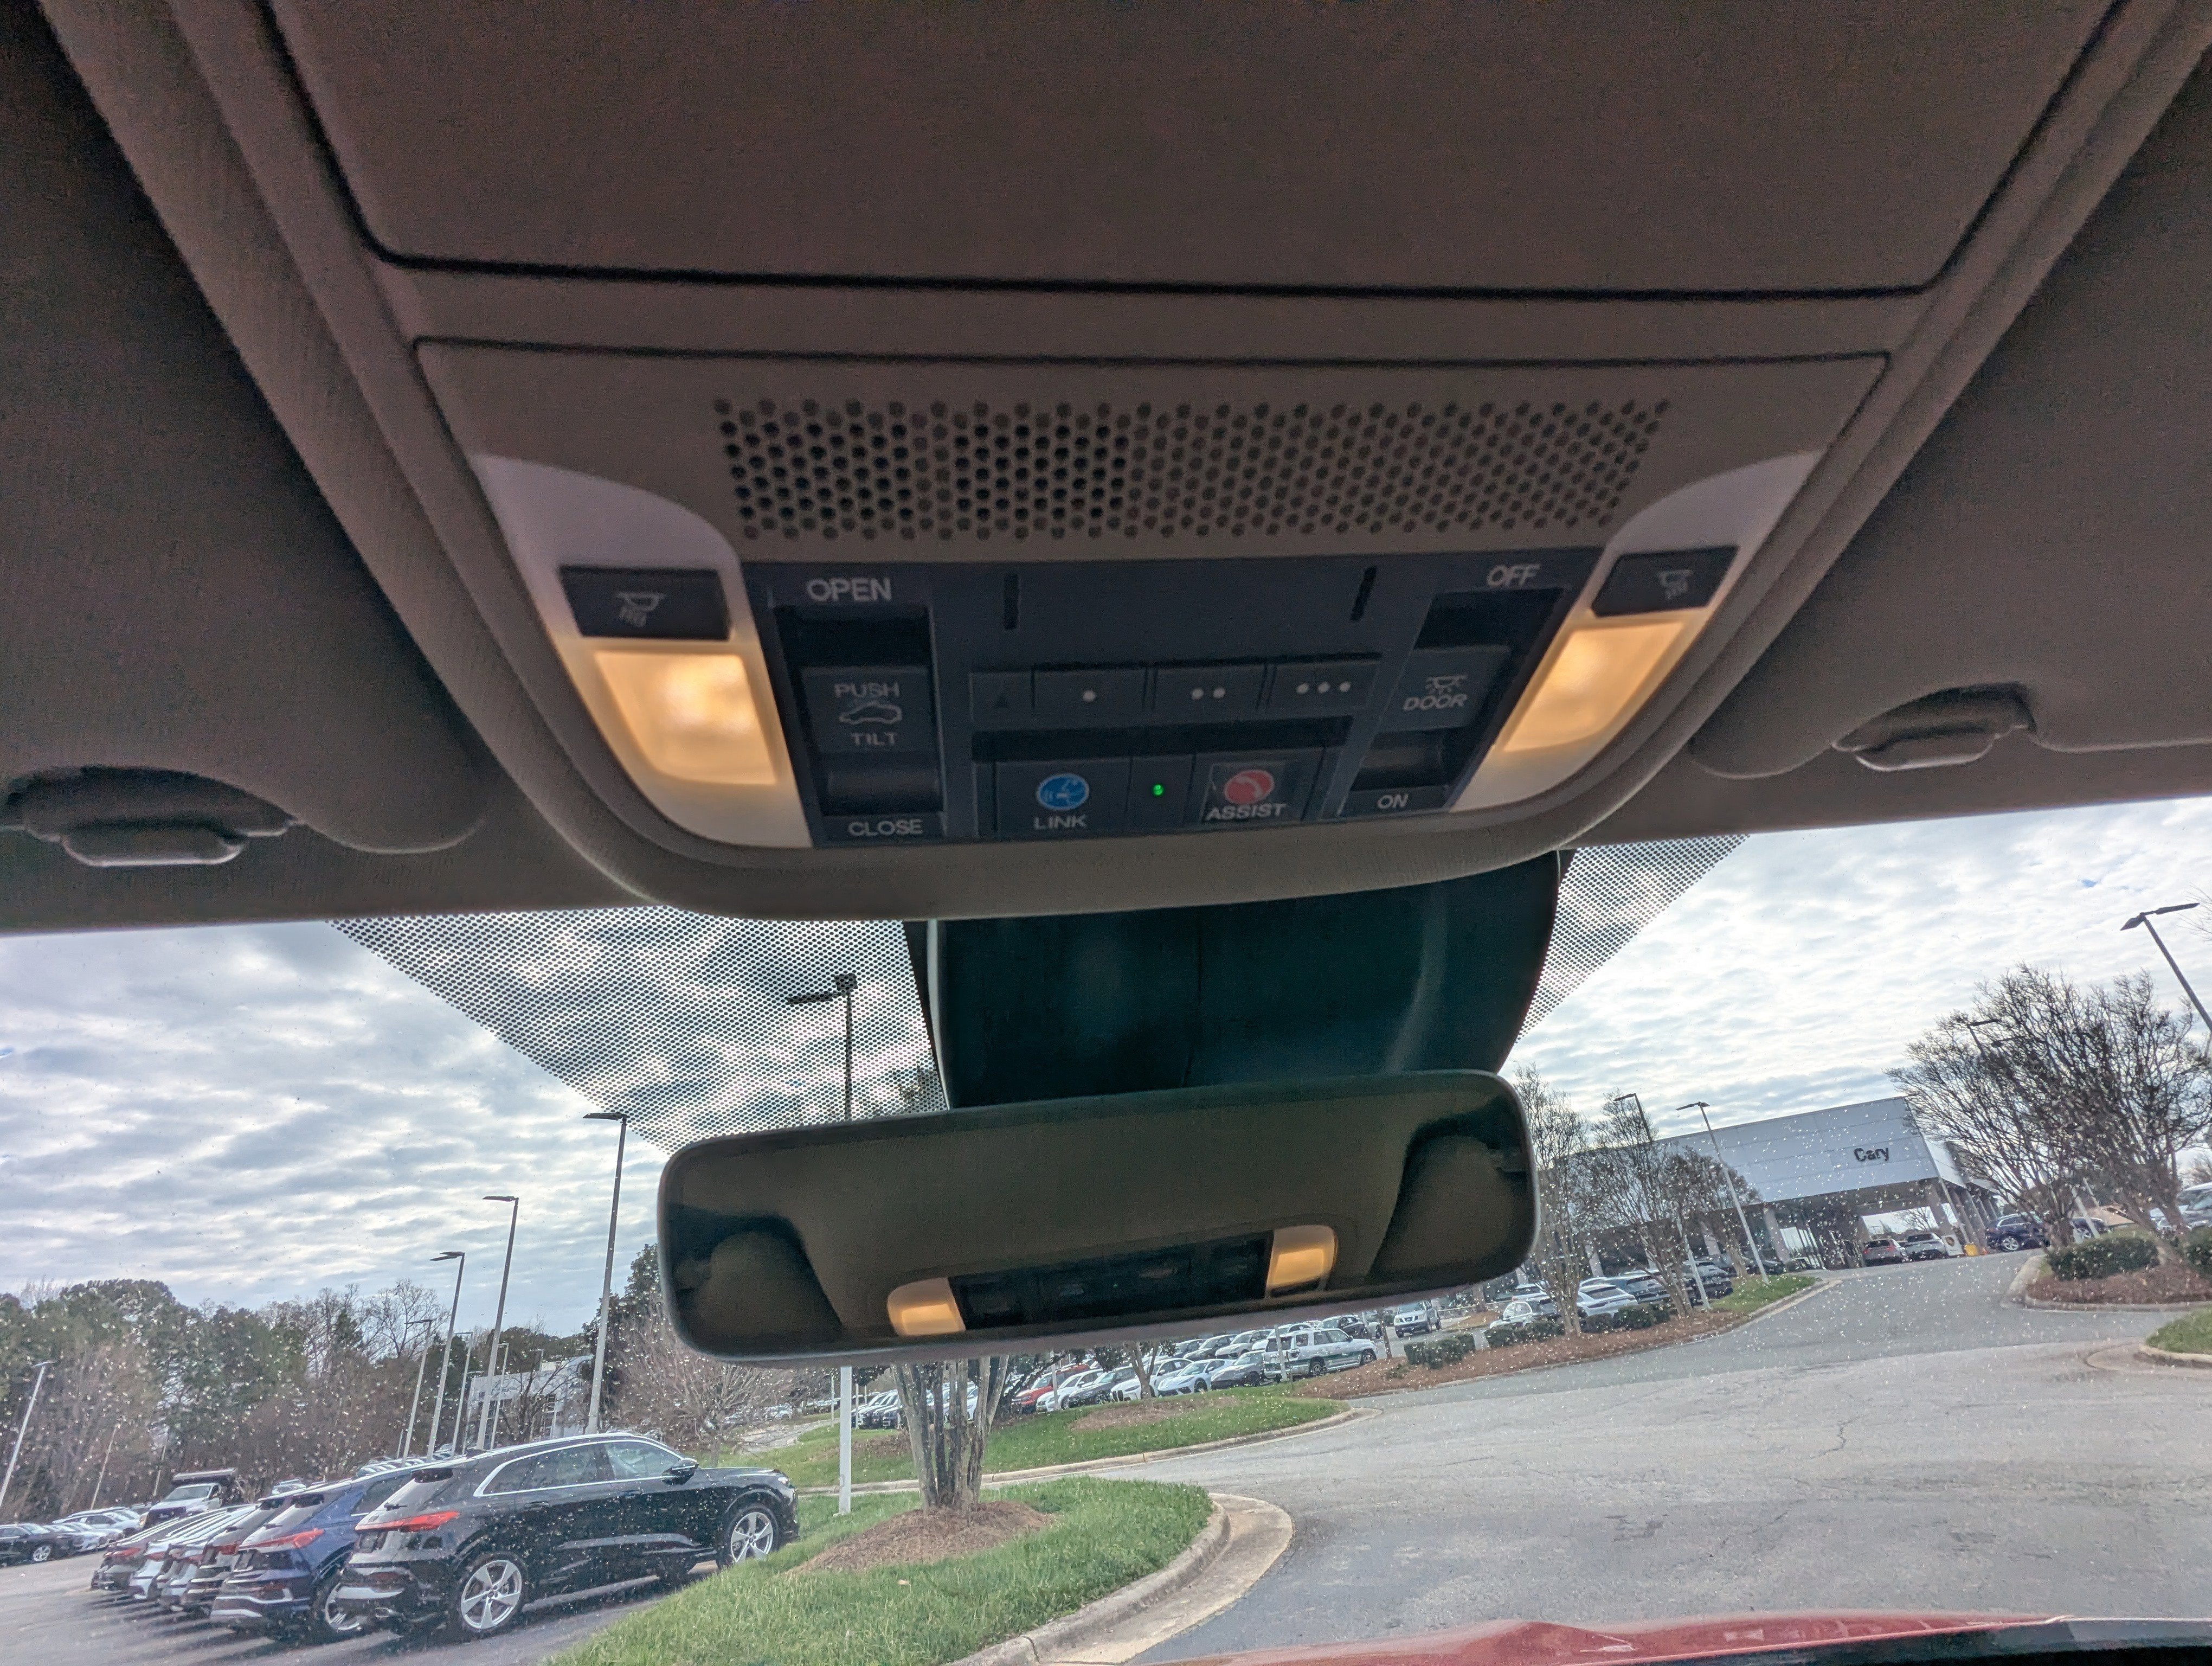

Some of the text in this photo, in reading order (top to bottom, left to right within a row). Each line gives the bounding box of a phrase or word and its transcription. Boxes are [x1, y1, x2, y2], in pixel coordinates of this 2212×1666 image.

[1487, 565, 1540, 586] OFF
[806, 578, 892, 603] OPEN
[834, 682, 900, 699] PUSH
[1404, 694, 1468, 710] DOOR
[851, 732, 898, 747] TILT
[1377, 793, 1409, 810] ON
[1206, 803, 1287, 821] ASSIST
[848, 818, 924, 837] CLOSE
[1033, 815, 1088, 830] LINK
[1854, 1148, 1889, 1162] Cary
